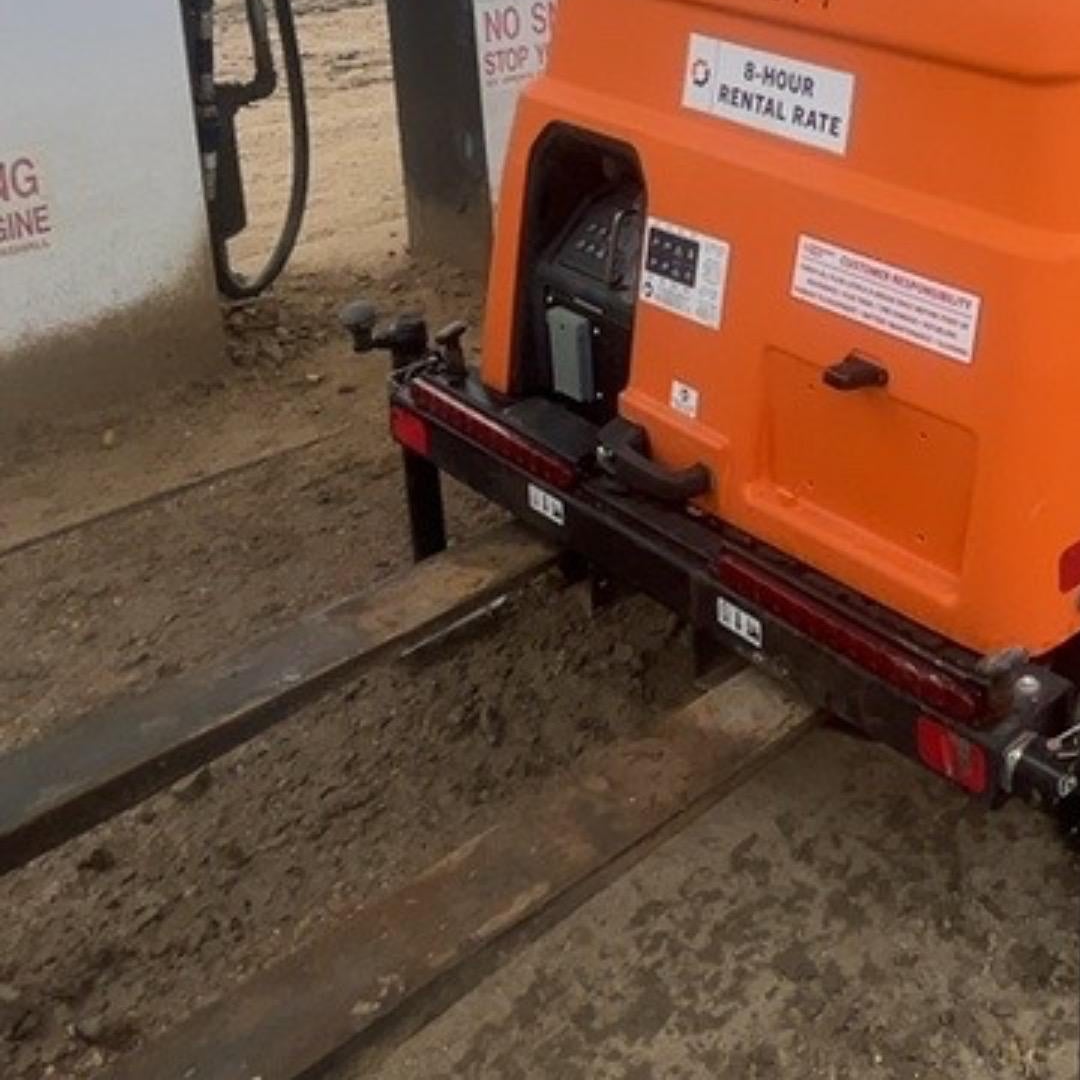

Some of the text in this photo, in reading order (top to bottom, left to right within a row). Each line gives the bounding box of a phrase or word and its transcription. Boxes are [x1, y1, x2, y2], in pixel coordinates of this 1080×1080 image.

[484, 5, 520, 42] NO
[484, 44, 529, 76] STOP
[743, 61, 815, 97] 8-HOUR
[717, 83, 842, 138] RENTAL RATE
